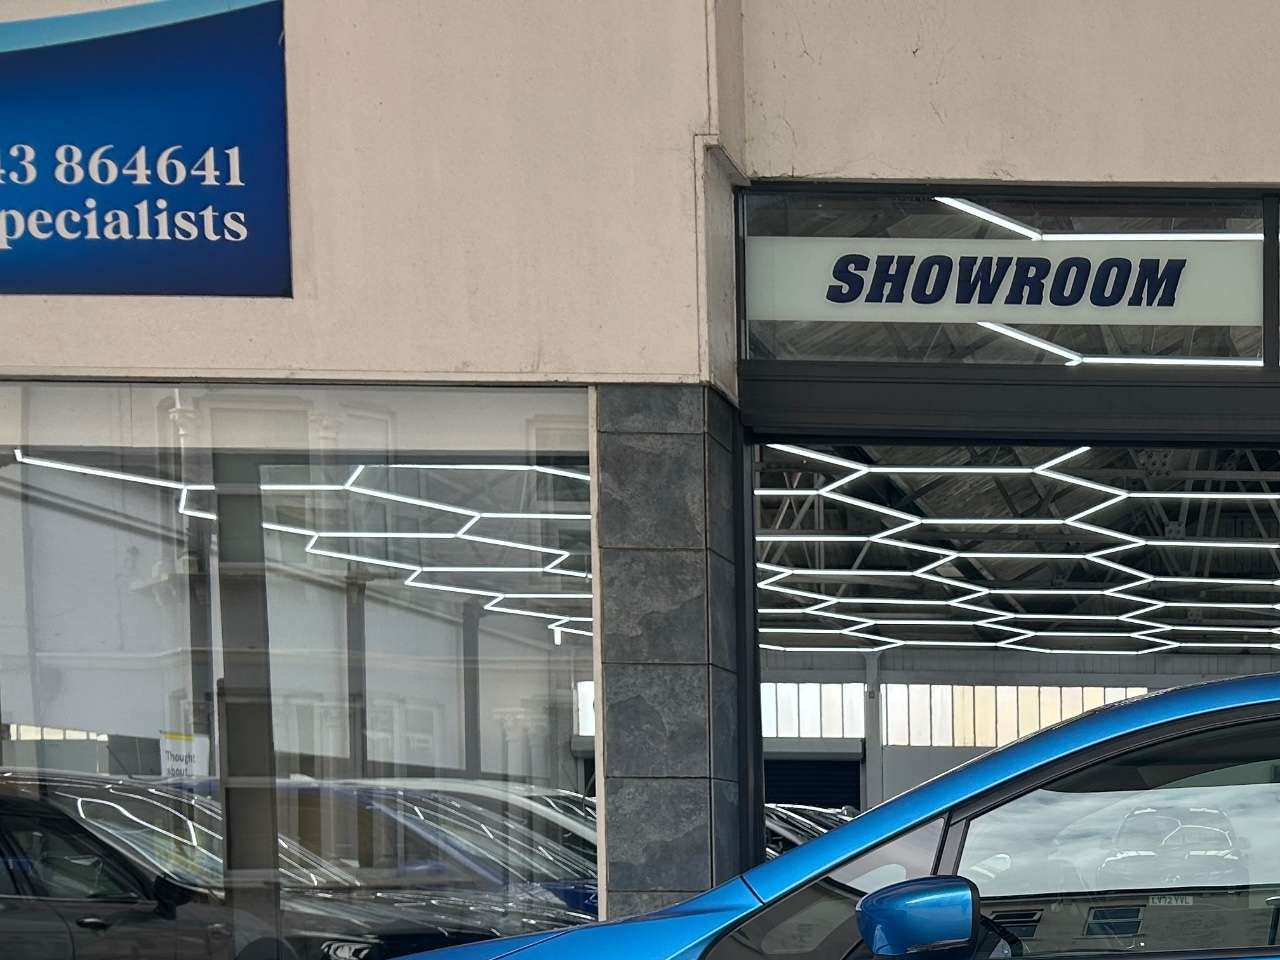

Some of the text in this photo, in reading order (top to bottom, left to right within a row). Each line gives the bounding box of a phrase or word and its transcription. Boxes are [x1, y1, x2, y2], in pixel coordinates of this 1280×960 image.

[0, 144, 245, 186] 3 864641
[825, 252, 1188, 309] SHOWROOM
[165, 750, 196, 764] Thought
